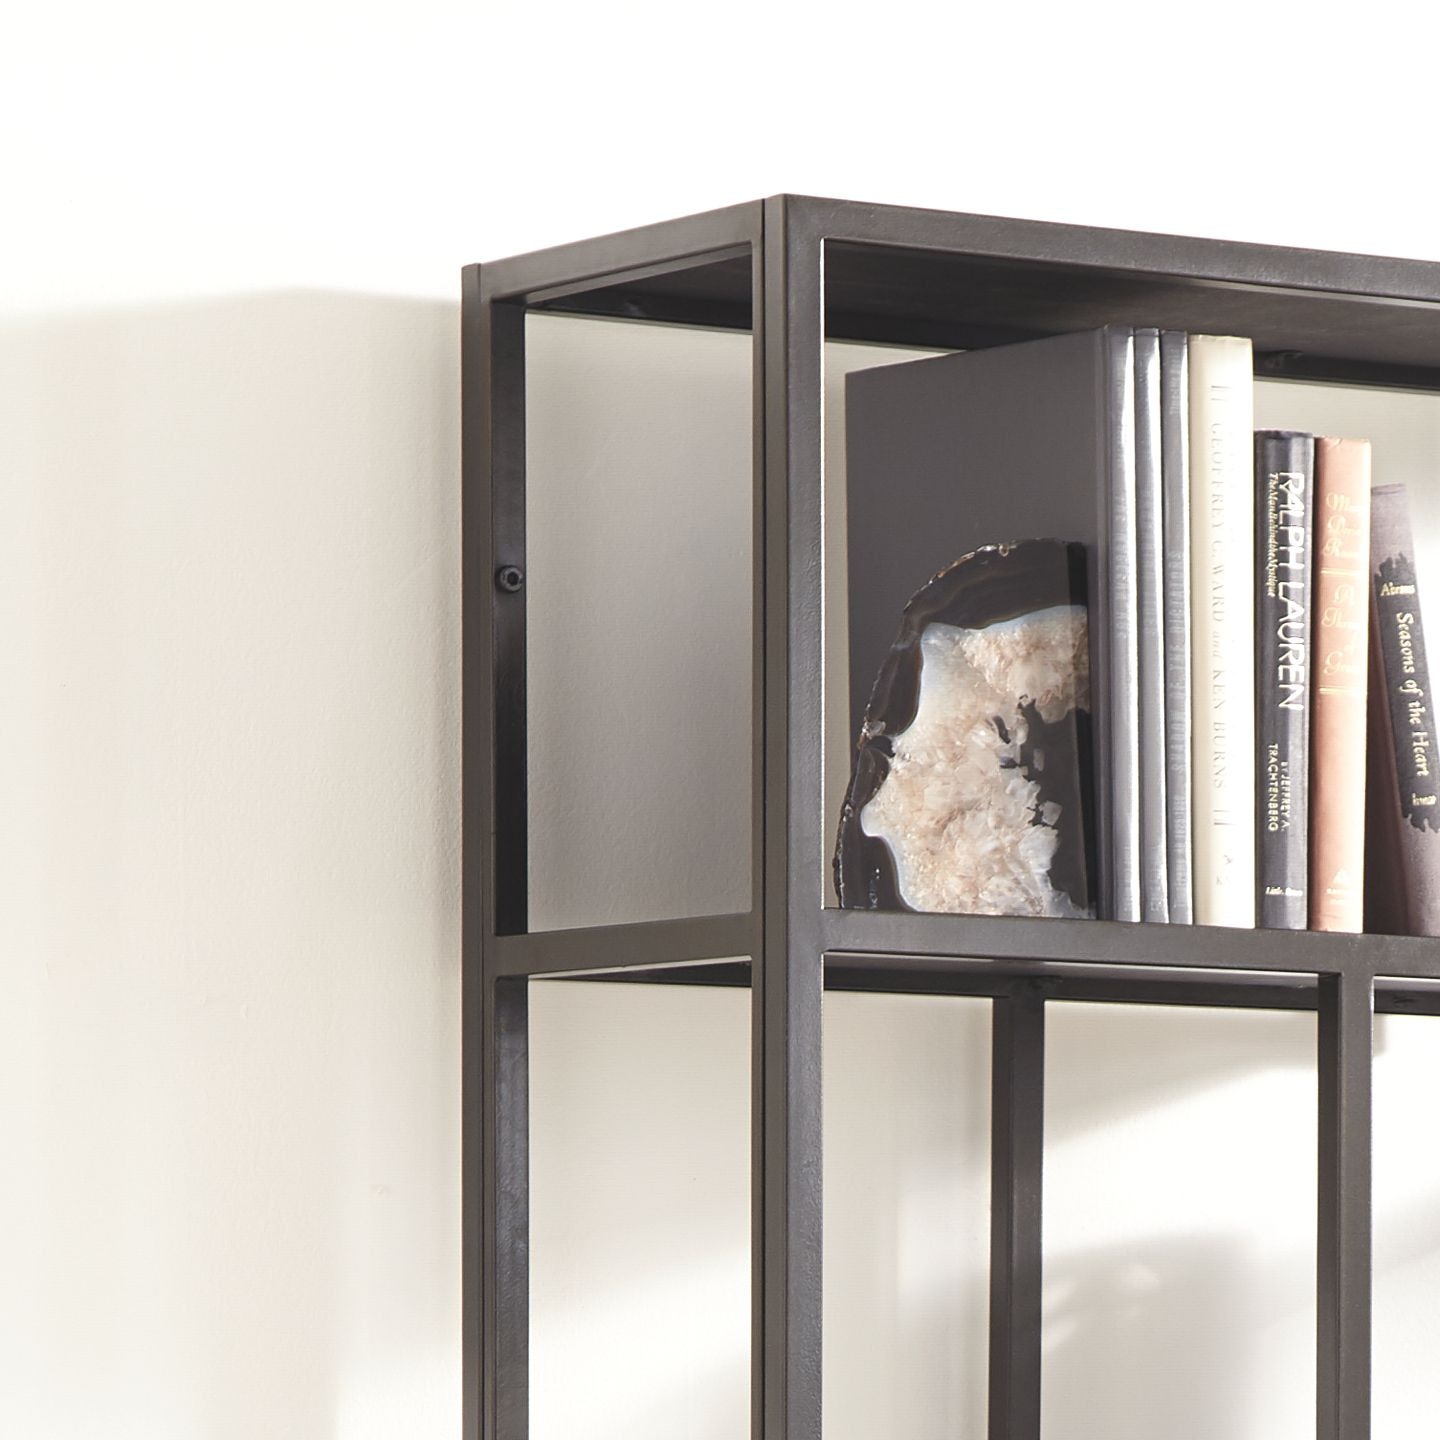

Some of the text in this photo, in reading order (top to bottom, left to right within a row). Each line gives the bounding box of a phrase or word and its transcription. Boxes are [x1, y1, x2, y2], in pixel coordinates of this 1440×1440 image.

[1212, 423, 1224, 528] GEOFFREY
[1212, 564, 1225, 622] WARD
[1266, 557, 1279, 597] Mystique
[1277, 472, 1305, 711] RALPH LAUREN
[1396, 612, 1415, 674] Seasons
[1213, 669, 1226, 709] KEN
[1399, 679, 1424, 697] of
[1408, 701, 1426, 725] the
[1213, 722, 1226, 789] BURNS
[1412, 731, 1430, 776] Heart
[1267, 743, 1279, 831] TRACHTENBERG
[1280, 774, 1291, 818] JEFFREY
